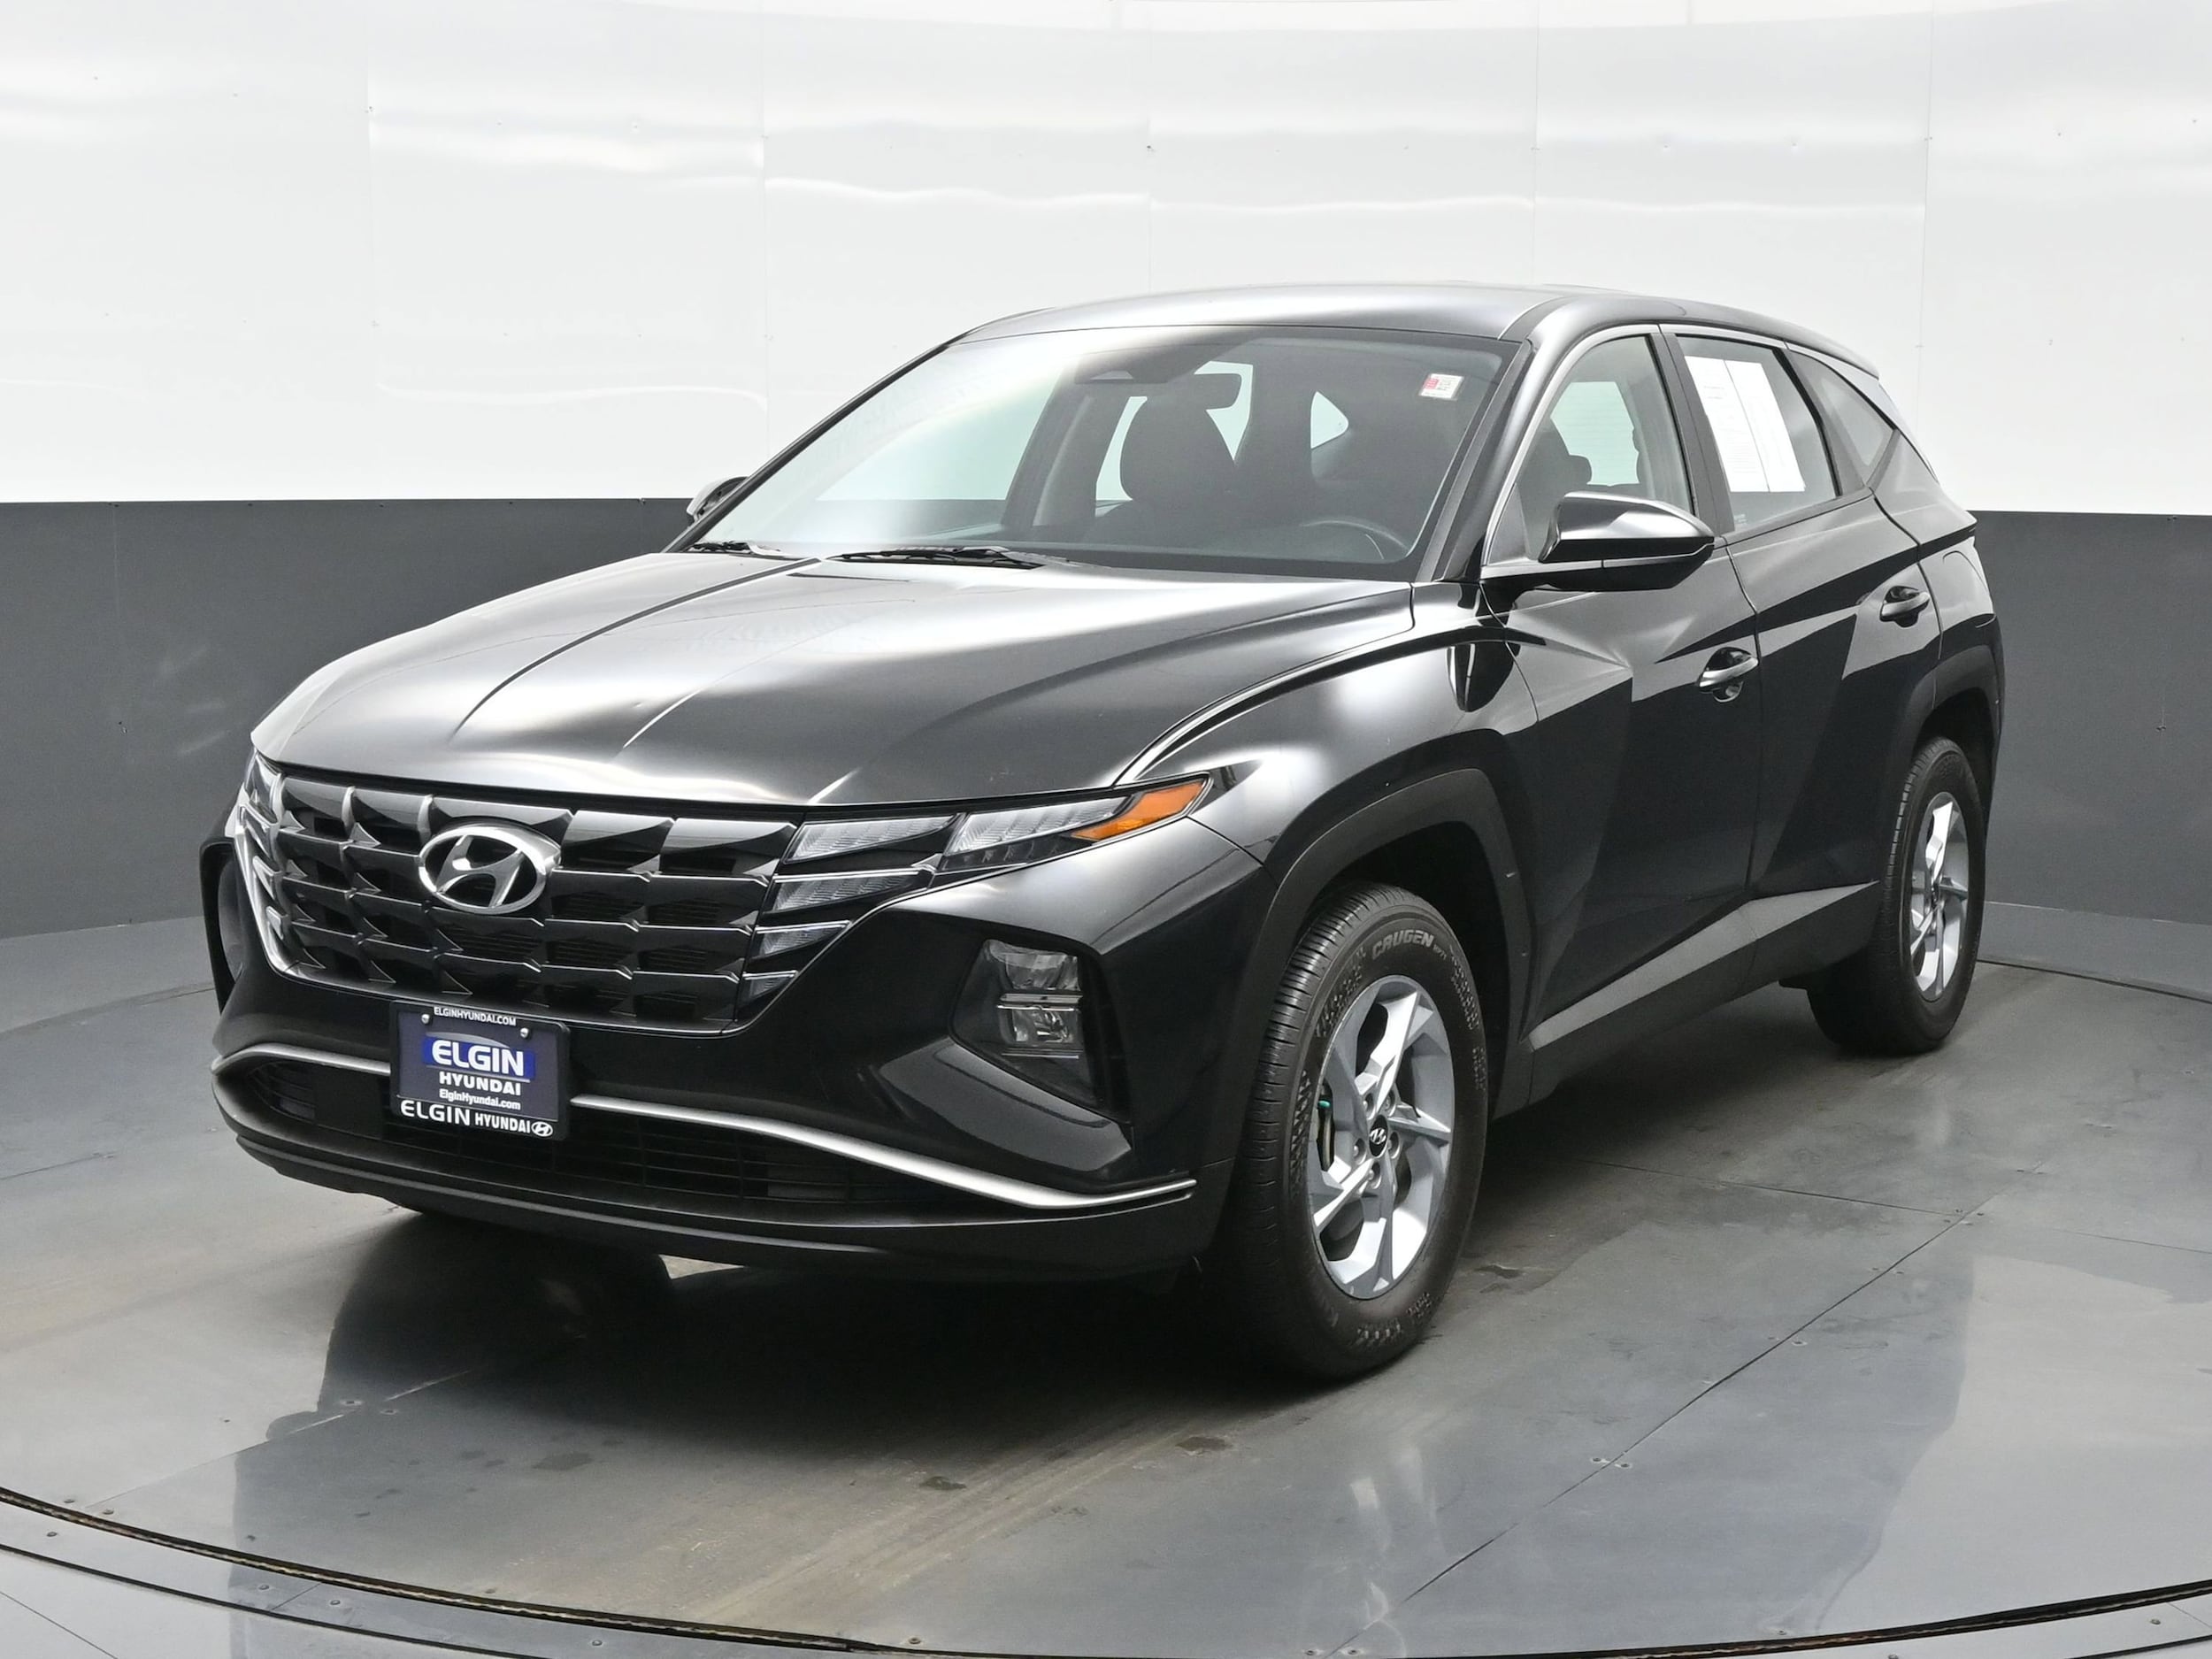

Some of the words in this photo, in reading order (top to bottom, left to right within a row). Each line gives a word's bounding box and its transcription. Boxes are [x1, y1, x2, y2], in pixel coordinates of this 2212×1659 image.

[434, 1006, 517, 1026] ELGINHYUNDAI.COM
[432, 1040, 524, 1076] ELGIN
[439, 1071, 521, 1096] HYUNDAI
[439, 1088, 521, 1110] ElginHyundai.com
[401, 1100, 470, 1126] ELGIN
[475, 1112, 531, 1133] HYUNDAI
